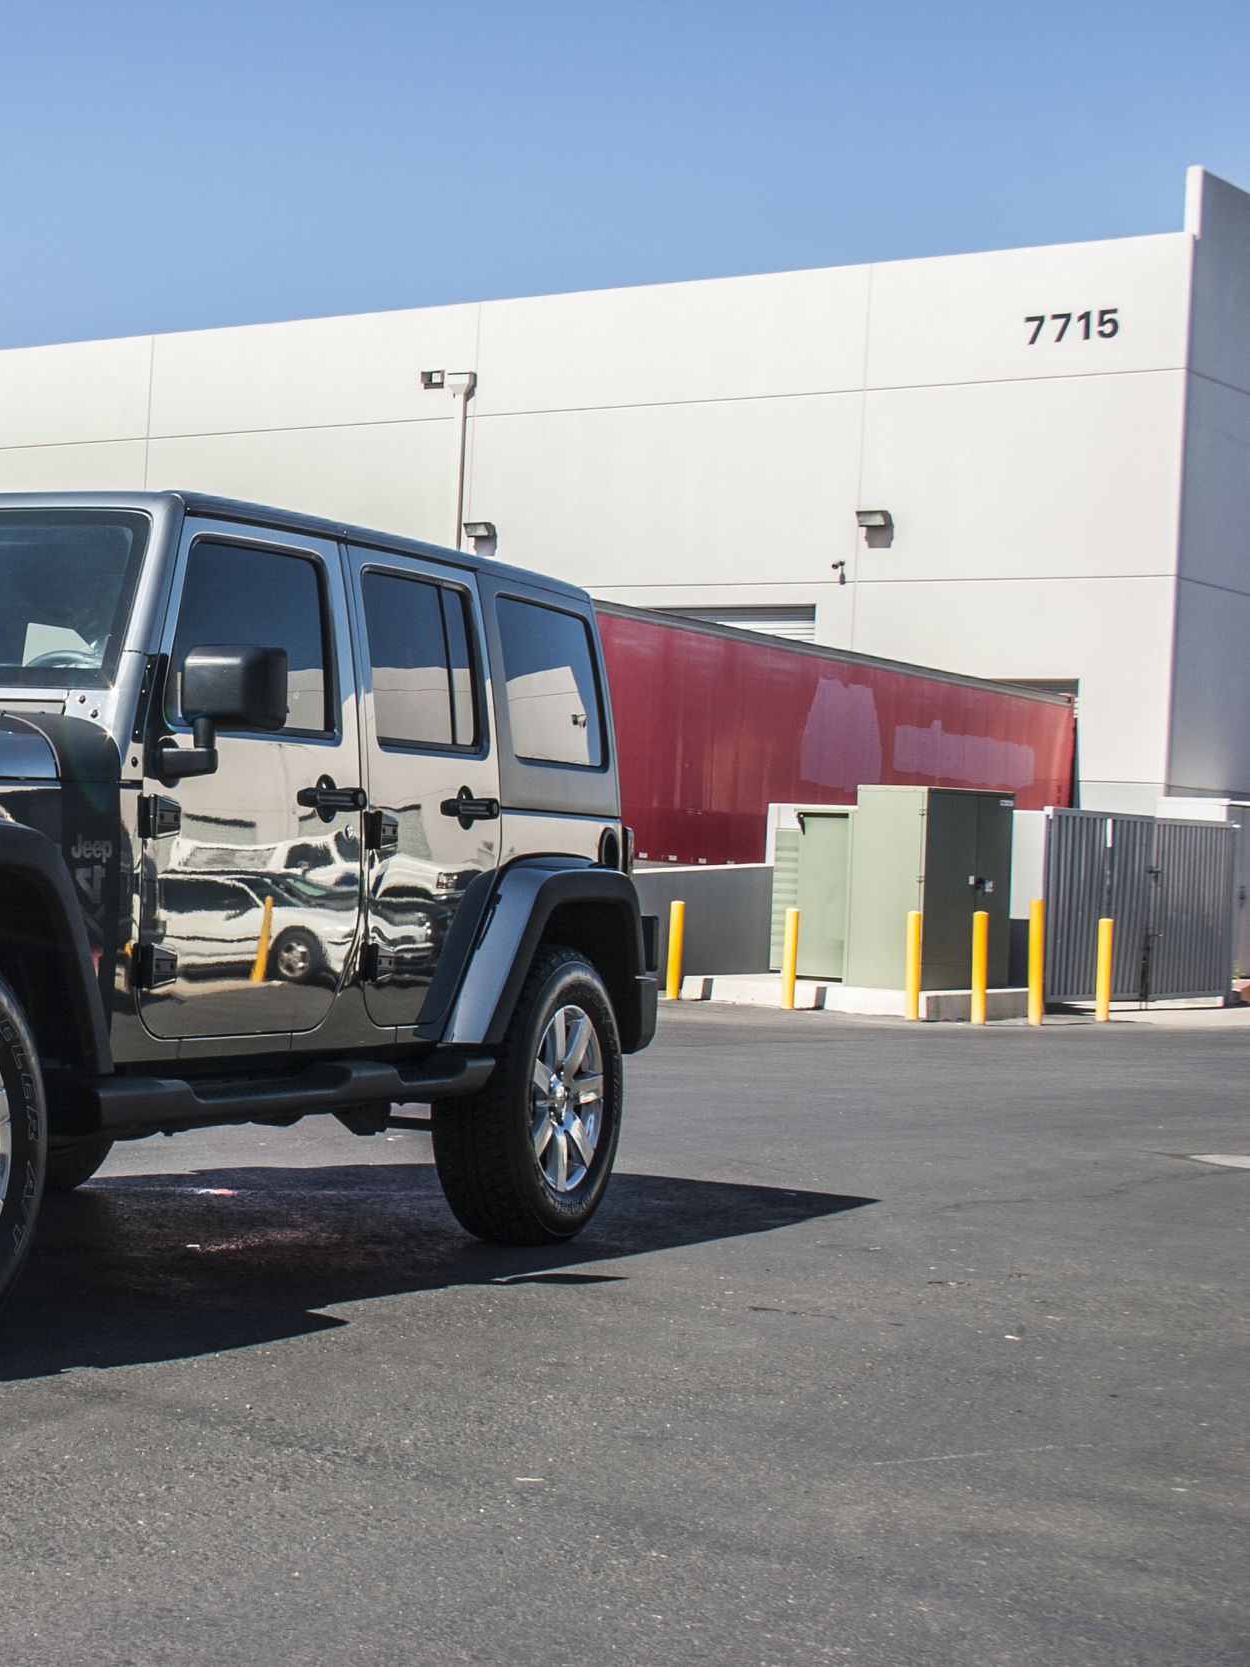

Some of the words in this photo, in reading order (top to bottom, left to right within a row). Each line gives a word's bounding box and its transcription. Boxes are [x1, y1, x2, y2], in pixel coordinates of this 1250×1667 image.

[1024, 308, 1119, 345] 7715
[71, 834, 113, 863] Jeep
[12, 1160, 37, 1256] A/T
